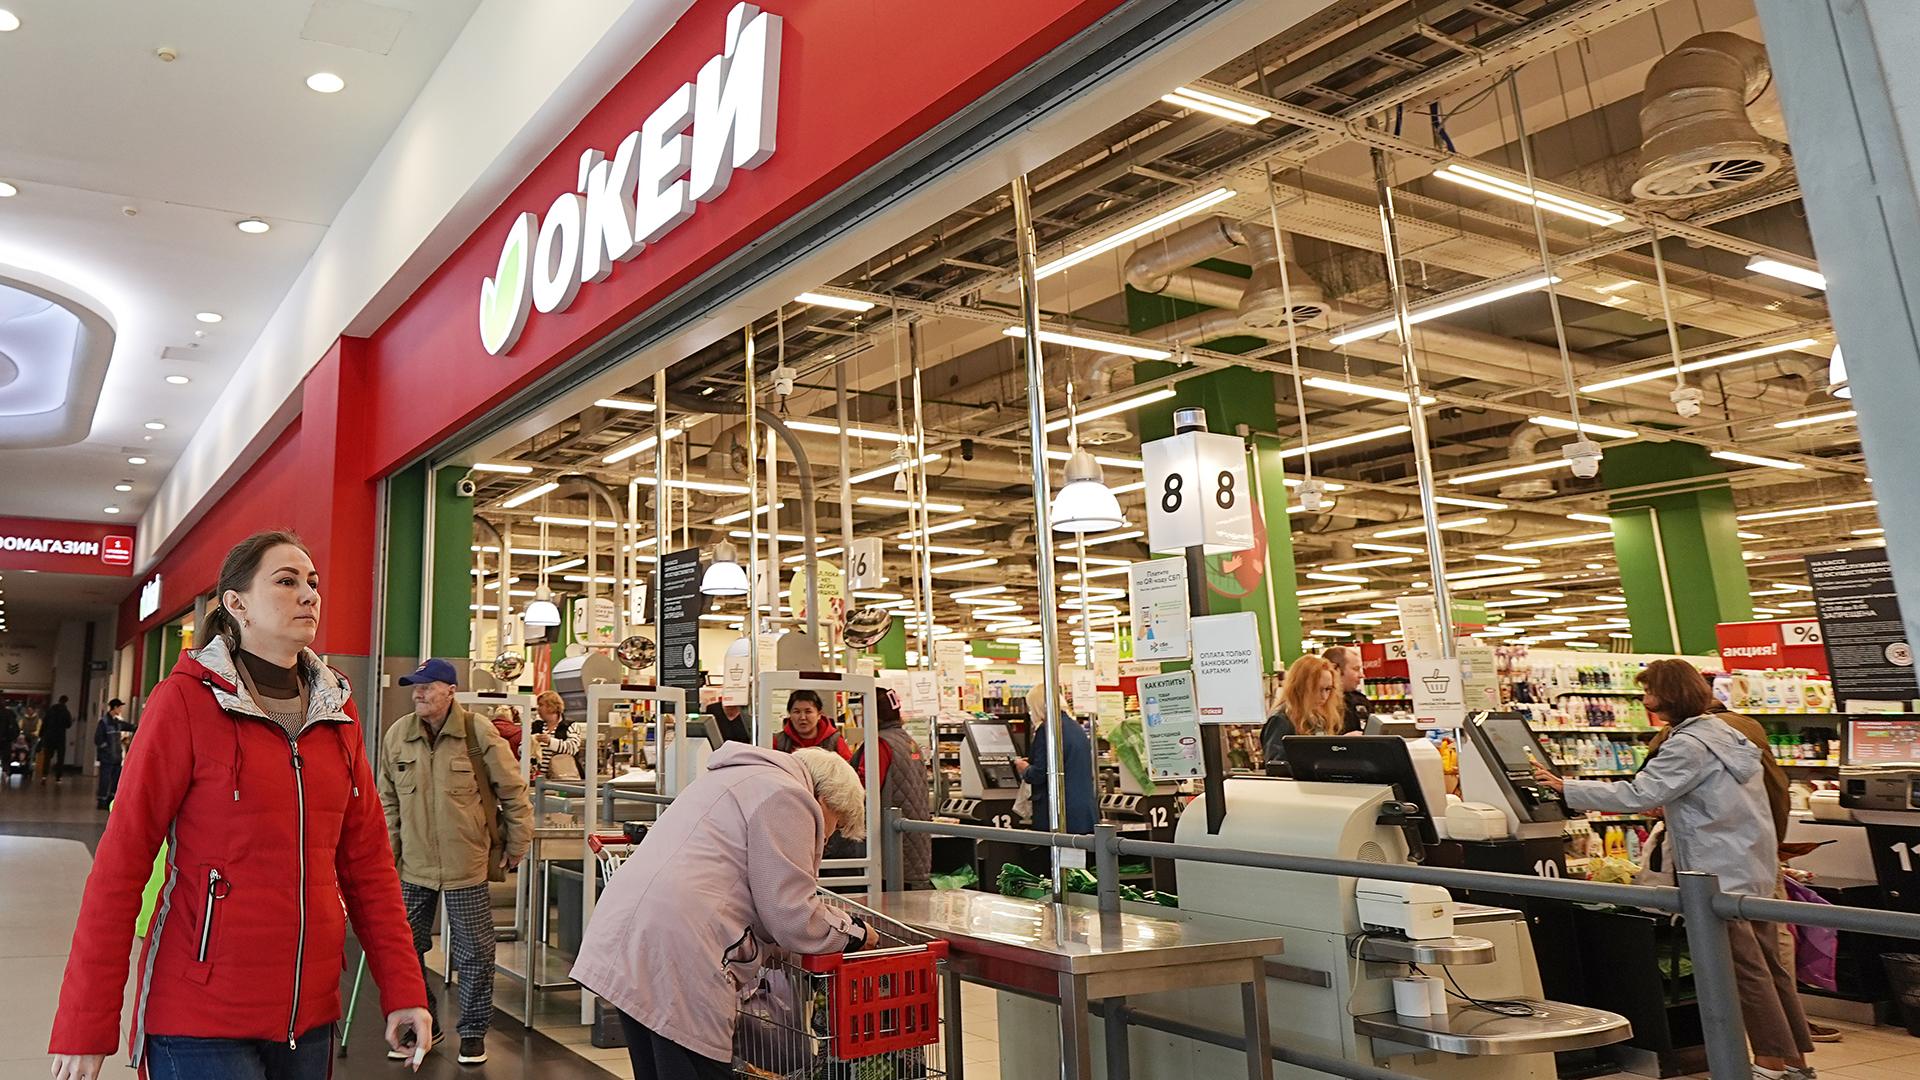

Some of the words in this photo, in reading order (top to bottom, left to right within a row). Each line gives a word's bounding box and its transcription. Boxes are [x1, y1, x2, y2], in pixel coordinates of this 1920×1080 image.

[1162, 473, 1183, 513] 8
[1216, 470, 1235, 510] 8
[1200, 651, 1224, 659] ОПЛАТА
[1226, 649, 1251, 657] ТОЛЬКО
[1723, 642, 1777, 658] акция!
[1201, 659, 1249, 667] БАНКОВСКИМИ
[1145, 680, 1157, 689] КАК
[1157, 678, 1186, 688] КУПИТЬ?
[992, 814, 1012, 829] 13
[1149, 807, 1169, 827] 12
[1534, 859, 1560, 880] 10
